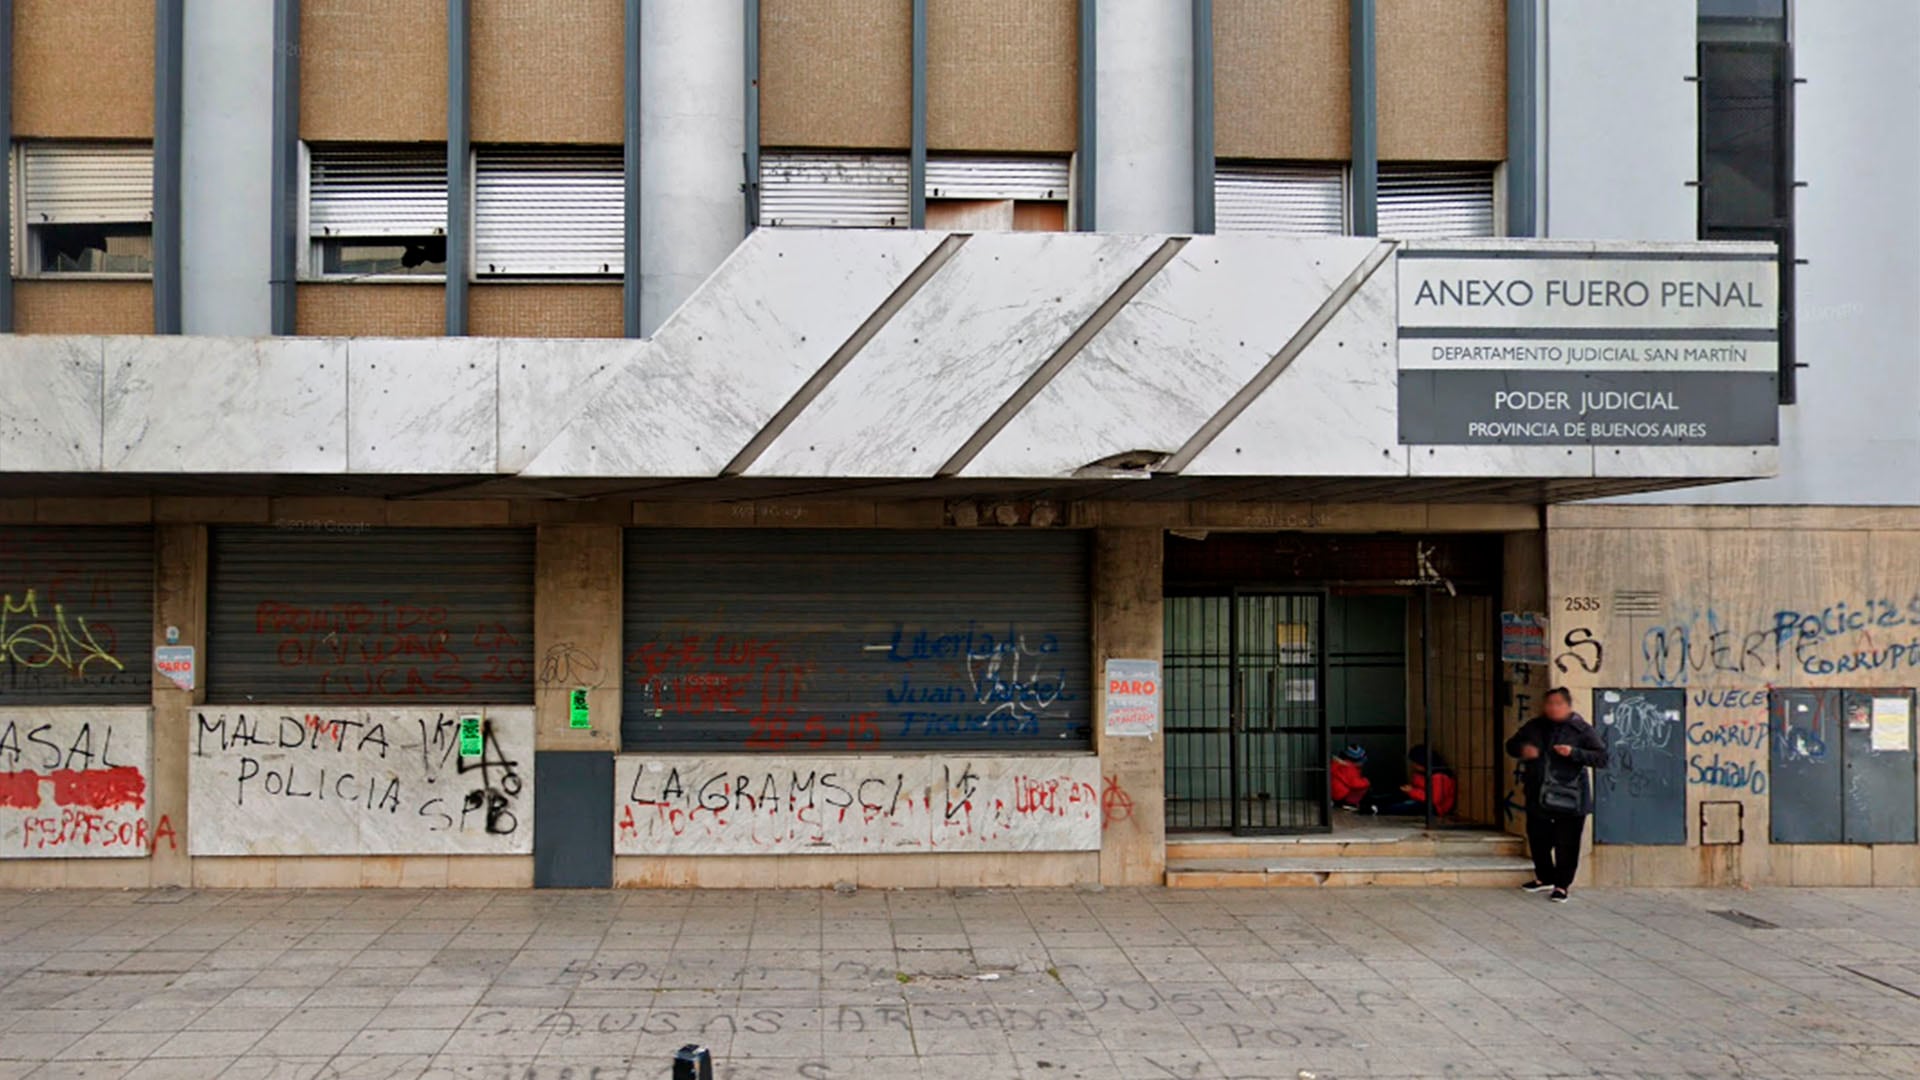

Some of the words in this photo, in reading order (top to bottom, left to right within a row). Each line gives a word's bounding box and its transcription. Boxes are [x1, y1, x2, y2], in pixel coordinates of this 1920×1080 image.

[1414, 279, 1534, 308] ANEXO
[1546, 279, 1649, 309] FUERO
[1660, 280, 1764, 309] PENAL
[1431, 345, 1563, 363] DEPARTAMENTO
[1566, 347, 1640, 364] JUDICIAL
[1643, 347, 1681, 363] SAN
[1683, 344, 1748, 364] MARTÍN
[1494, 391, 1571, 411] PODER
[1578, 391, 1679, 416] JUDICIAL
[1467, 422, 1560, 438] PROVINCIA
[1563, 423, 1587, 438] DE
[1590, 423, 1660, 438] BUENOS
[1661, 423, 1707, 438] AIRES
[1564, 597, 1601, 612] 2535
[1108, 679, 1155, 696] PARO
[237, 757, 401, 814] POLICIA
